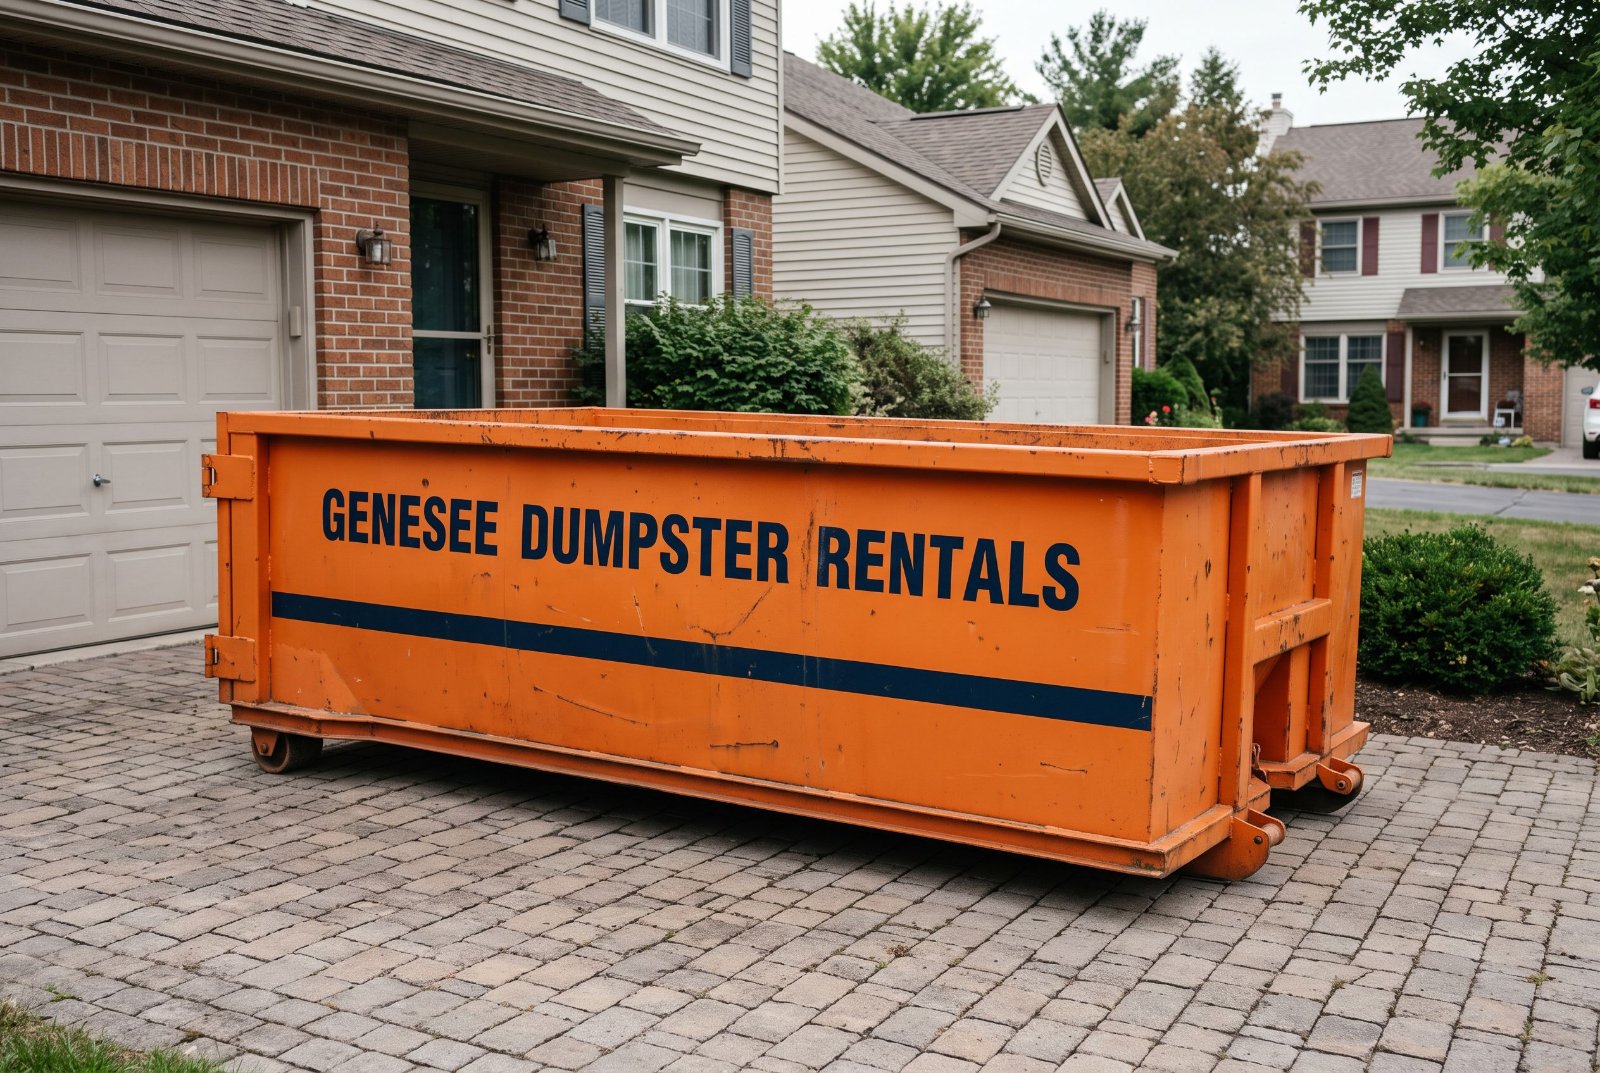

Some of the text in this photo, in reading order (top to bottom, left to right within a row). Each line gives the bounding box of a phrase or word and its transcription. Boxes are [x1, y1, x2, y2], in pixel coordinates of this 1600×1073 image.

[322, 487, 1081, 612] GENESEE DUMPSTER RENTALS
